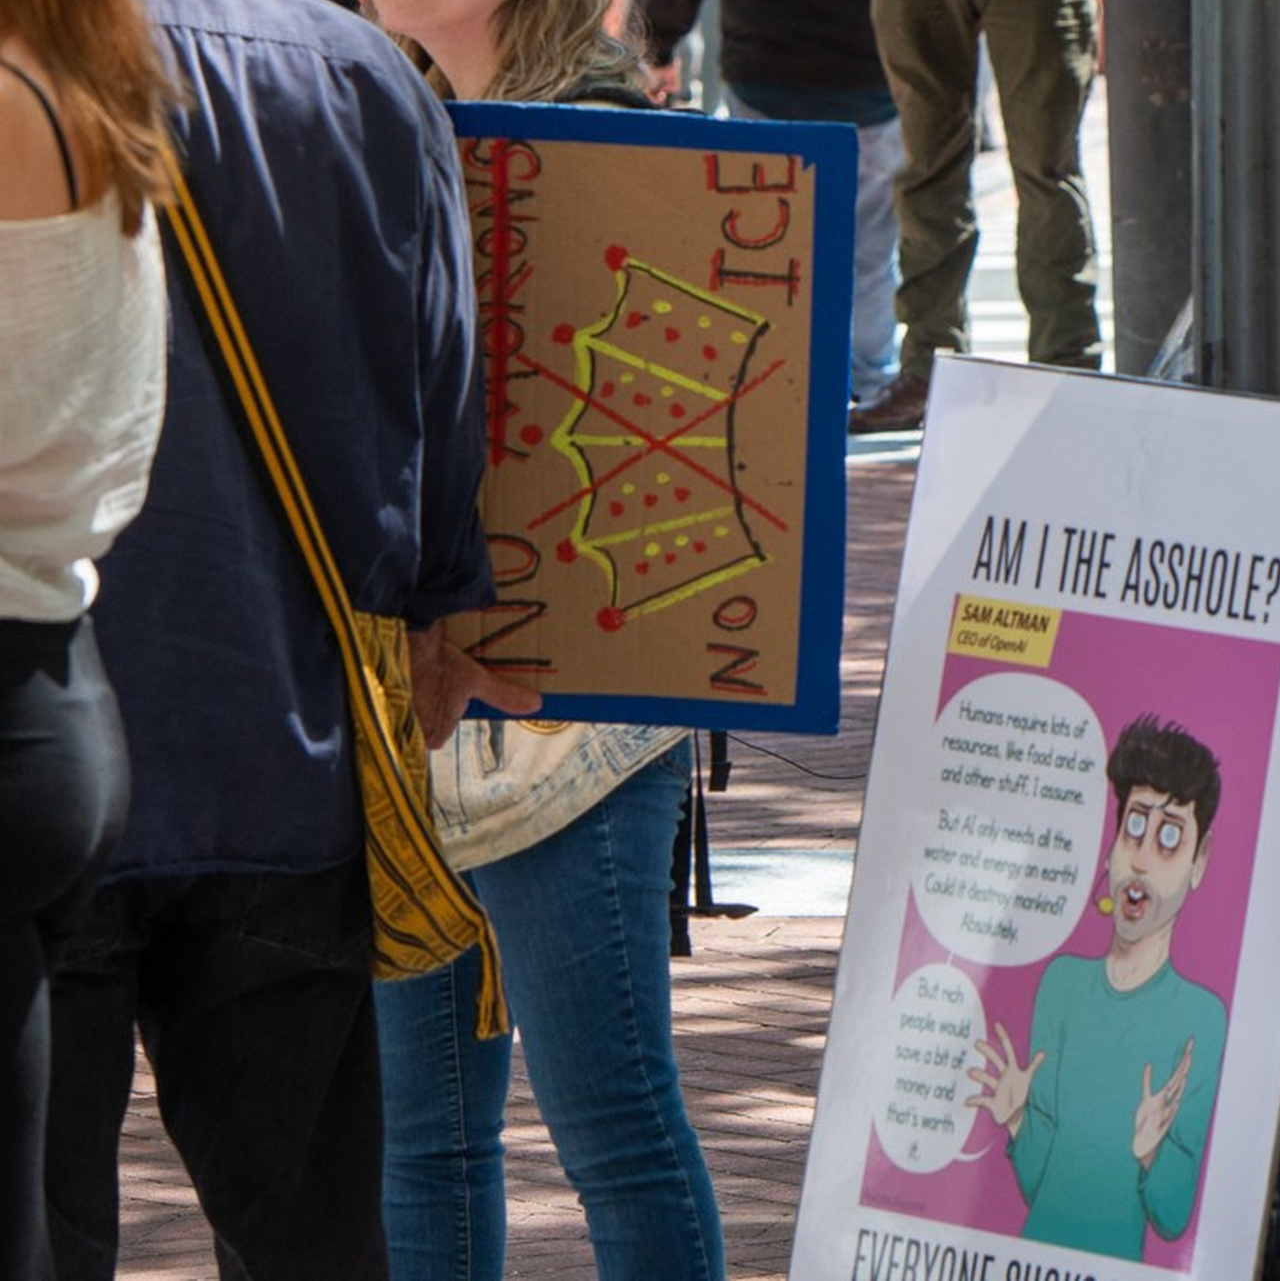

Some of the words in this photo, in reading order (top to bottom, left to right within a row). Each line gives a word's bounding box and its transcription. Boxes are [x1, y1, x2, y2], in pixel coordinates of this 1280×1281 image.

[704, 153, 802, 306] ICE
[972, 515, 1028, 585] AM
[1033, 523, 1050, 589] I
[1058, 527, 1116, 598] THE
[961, 602, 993, 625] SAM
[992, 607, 1051, 634] ALTMAN
[706, 594, 767, 696] NO
[957, 629, 979, 647] CEO
[978, 632, 992, 647] of
[990, 634, 1029, 653] OpenAI
[959, 700, 1004, 727] Humans
[1007, 713, 1048, 735] require
[1050, 713, 1071, 737] lots
[1073, 718, 1089, 739] of
[1006, 740, 1025, 763] like
[1027, 742, 1052, 766] food
[1054, 751, 1077, 770] and
[1077, 757, 1094, 772] air
[940, 764, 962, 784] and
[964, 766, 995, 789] other
[1032, 776, 1040, 797] I
[937, 808, 960, 831] But
[977, 819, 1000, 843] only
[1002, 823, 1035, 846] needs
[1037, 828, 1051, 847] all
[1053, 831, 1073, 853] the
[923, 844, 957, 863] water
[959, 850, 982, 868] and
[983, 858, 1024, 880] energy
[1041, 866, 1078, 885] earth!
[925, 872, 956, 896] Could
[956, 882, 967, 897] it
[968, 882, 1012, 909] destroy
[1015, 893, 1067, 916] mankind?
[917, 976, 939, 1000] But
[942, 985, 964, 1004] rich
[900, 1012, 936, 1033] people
[939, 1018, 972, 1040] would
[896, 1045, 921, 1064] save
[923, 1052, 932, 1065] a
[933, 1045, 950, 1067] bit
[951, 1050, 967, 1070] of
[896, 1078, 931, 1101] money
[933, 1081, 957, 1102] and
[887, 1102, 919, 1127] that's
[921, 1114, 955, 1133] worth
